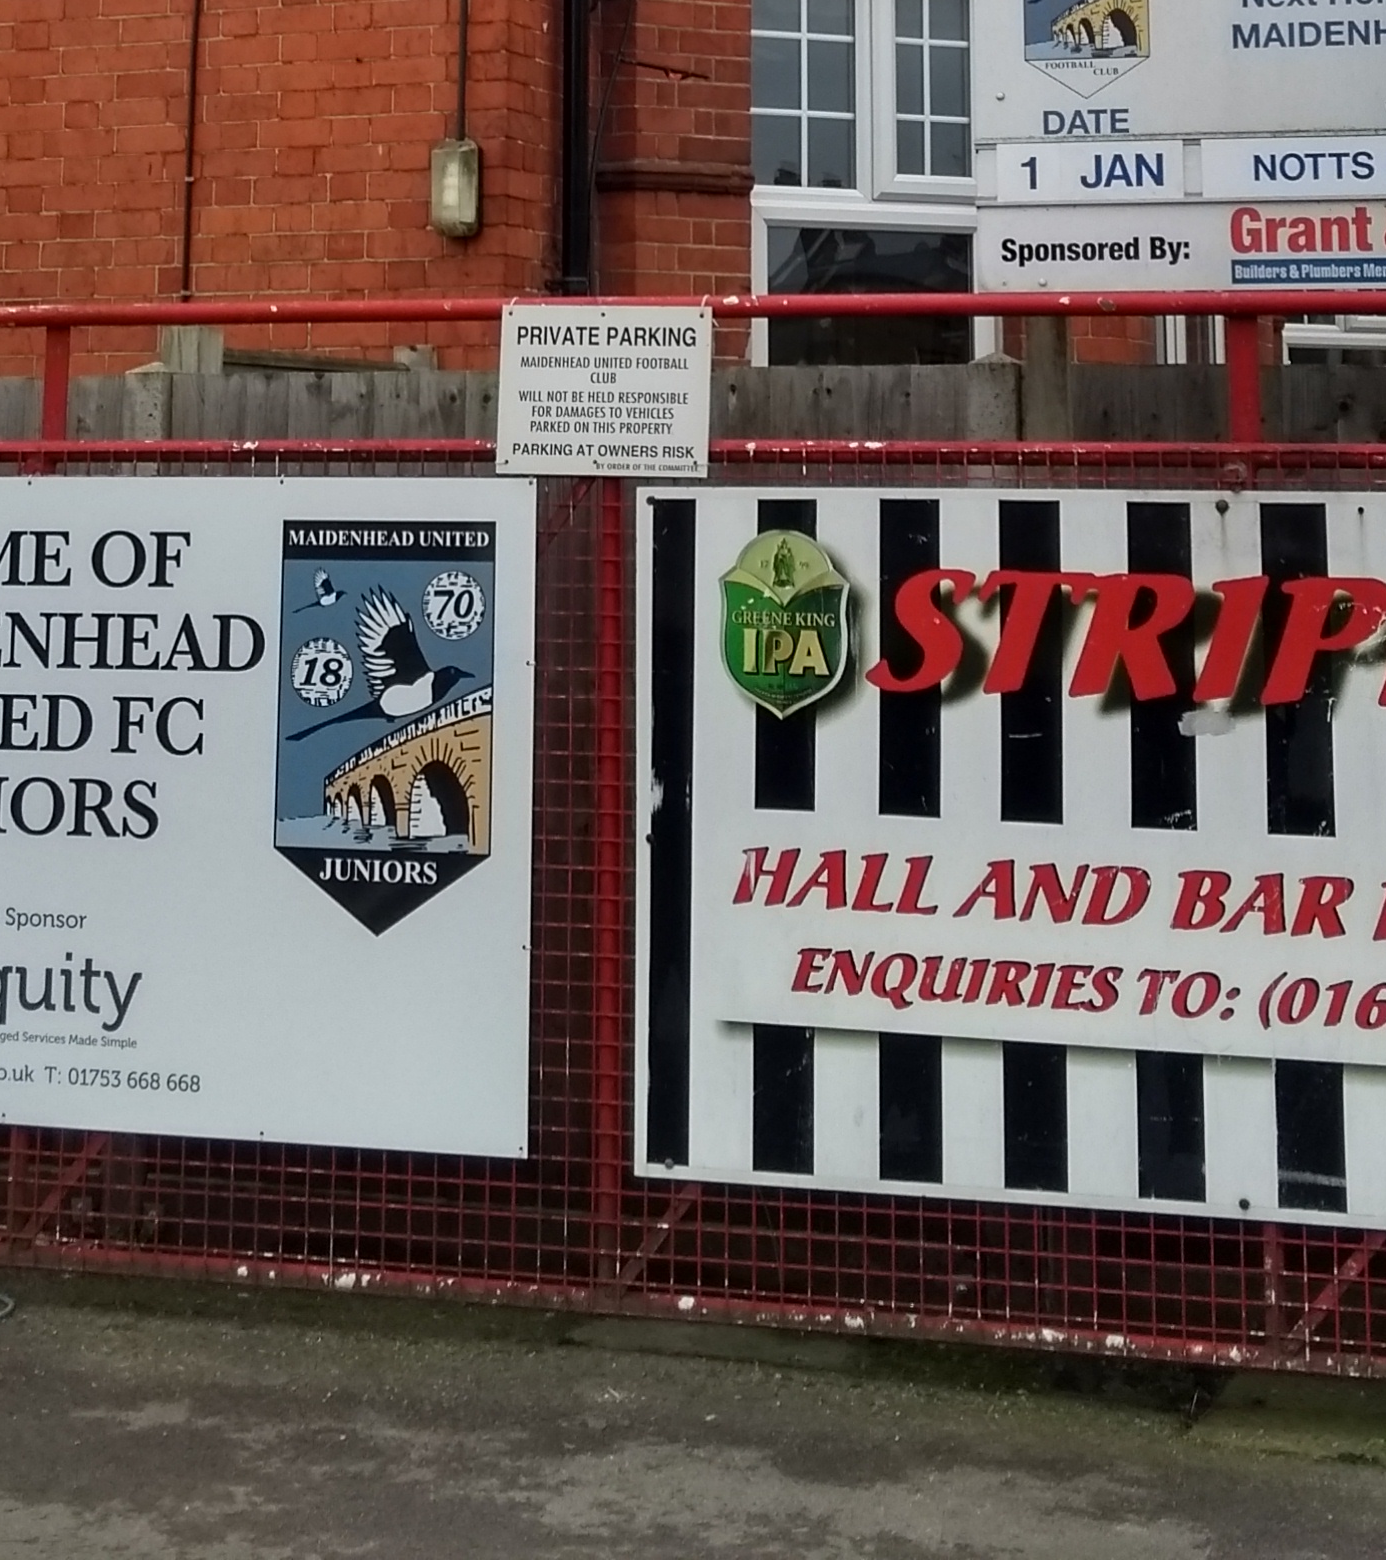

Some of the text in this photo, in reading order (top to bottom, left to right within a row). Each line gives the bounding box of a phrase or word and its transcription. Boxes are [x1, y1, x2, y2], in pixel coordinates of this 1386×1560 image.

[1045, 61, 1096, 70] FOOTBALL
[1093, 68, 1119, 76] CLUB
[1043, 108, 1130, 136] DATE
[1020, 152, 1165, 190] 1 JAN
[1253, 151, 1375, 182] NOTTS
[1230, 206, 1373, 254] Grant
[1001, 236, 1191, 267] Sponsored By:
[1234, 262, 1288, 280] Builders
[1289, 263, 1300, 279] &
[1301, 262, 1361, 279] Plumbers
[517, 326, 697, 347] PRIVATE PARKING
[520, 356, 689, 370] MAIDENHEAD UNITED FOOTBALL
[590, 372, 617, 384] CLUB
[519, 391, 689, 405] WILL NOT BE HELD RESPONSIBLE
[532, 406, 674, 420] FOR DAMAGES TO VEHICLES
[530, 421, 570, 433] PARKED
[574, 422, 589, 433] ON
[593, 422, 616, 434] THIS
[512, 443, 694, 459] PARKING AT OWNERS RISK
[607, 463, 630, 471] ORDER
[632, 463, 642, 471] OF
[288, 529, 489, 548] MAIDENHEAD UNITED
[90, 529, 192, 589] OF
[433, 589, 474, 620] 70
[732, 610, 836, 627] GREENE KING
[743, 628, 830, 676] IPA
[299, 656, 344, 687] 18
[111, 695, 205, 756] FC
[319, 858, 437, 885] JUNIORS
[733, 846, 939, 916] HALL
[952, 858, 1152, 925] AND
[1170, 870, 1355, 939] BAR
[5, 907, 87, 931] Sponsor
[791, 947, 1124, 1011] ENQUIRIES
[1137, 968, 1242, 1021] TO:
[23, 1031, 66, 1044] Services
[68, 1034, 98, 1046] Made
[101, 1036, 137, 1050] Simple
[45, 1066, 62, 1086] T:
[68, 1068, 121, 1089] 01753
[126, 1072, 161, 1092] 668
[166, 1074, 201, 1093] 668
